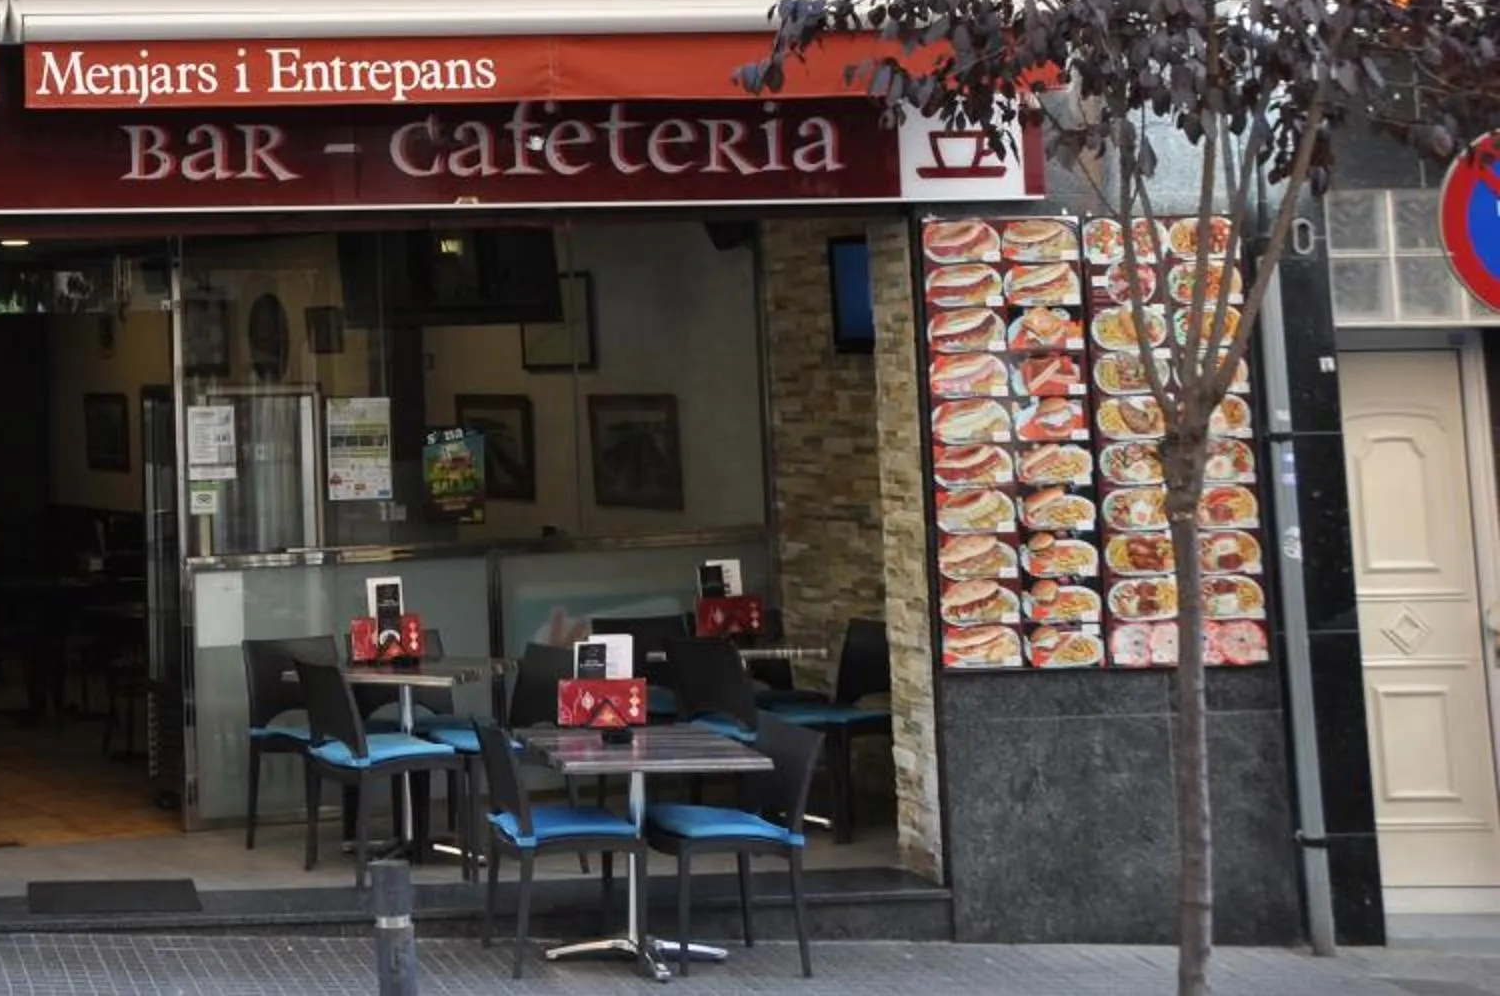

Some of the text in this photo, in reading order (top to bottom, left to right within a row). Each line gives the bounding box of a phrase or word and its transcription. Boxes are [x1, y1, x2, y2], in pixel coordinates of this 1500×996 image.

[36, 48, 497, 104] Menjars i Entrepans
